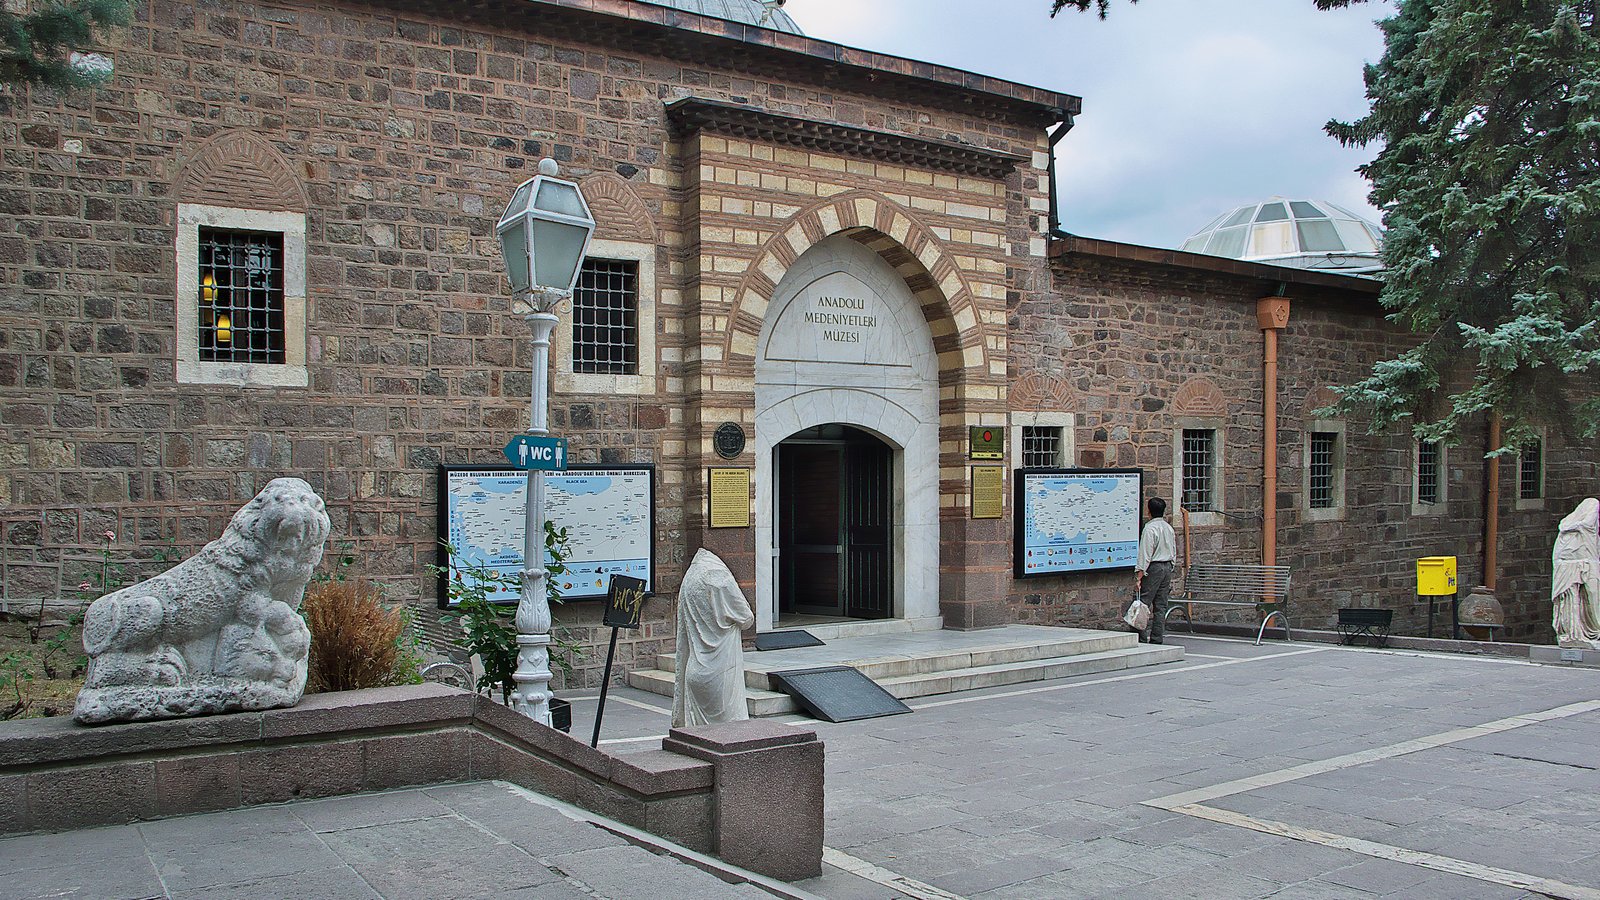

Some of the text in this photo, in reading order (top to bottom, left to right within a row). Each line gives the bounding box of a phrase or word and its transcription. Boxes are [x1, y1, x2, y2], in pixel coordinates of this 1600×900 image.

[818, 296, 864, 309] ANADOLU
[804, 312, 876, 327] MEDENİYETLERİ
[823, 329, 859, 343] MÜZESİ
[530, 446, 552, 460] WC
[614, 586, 632, 612] WC
